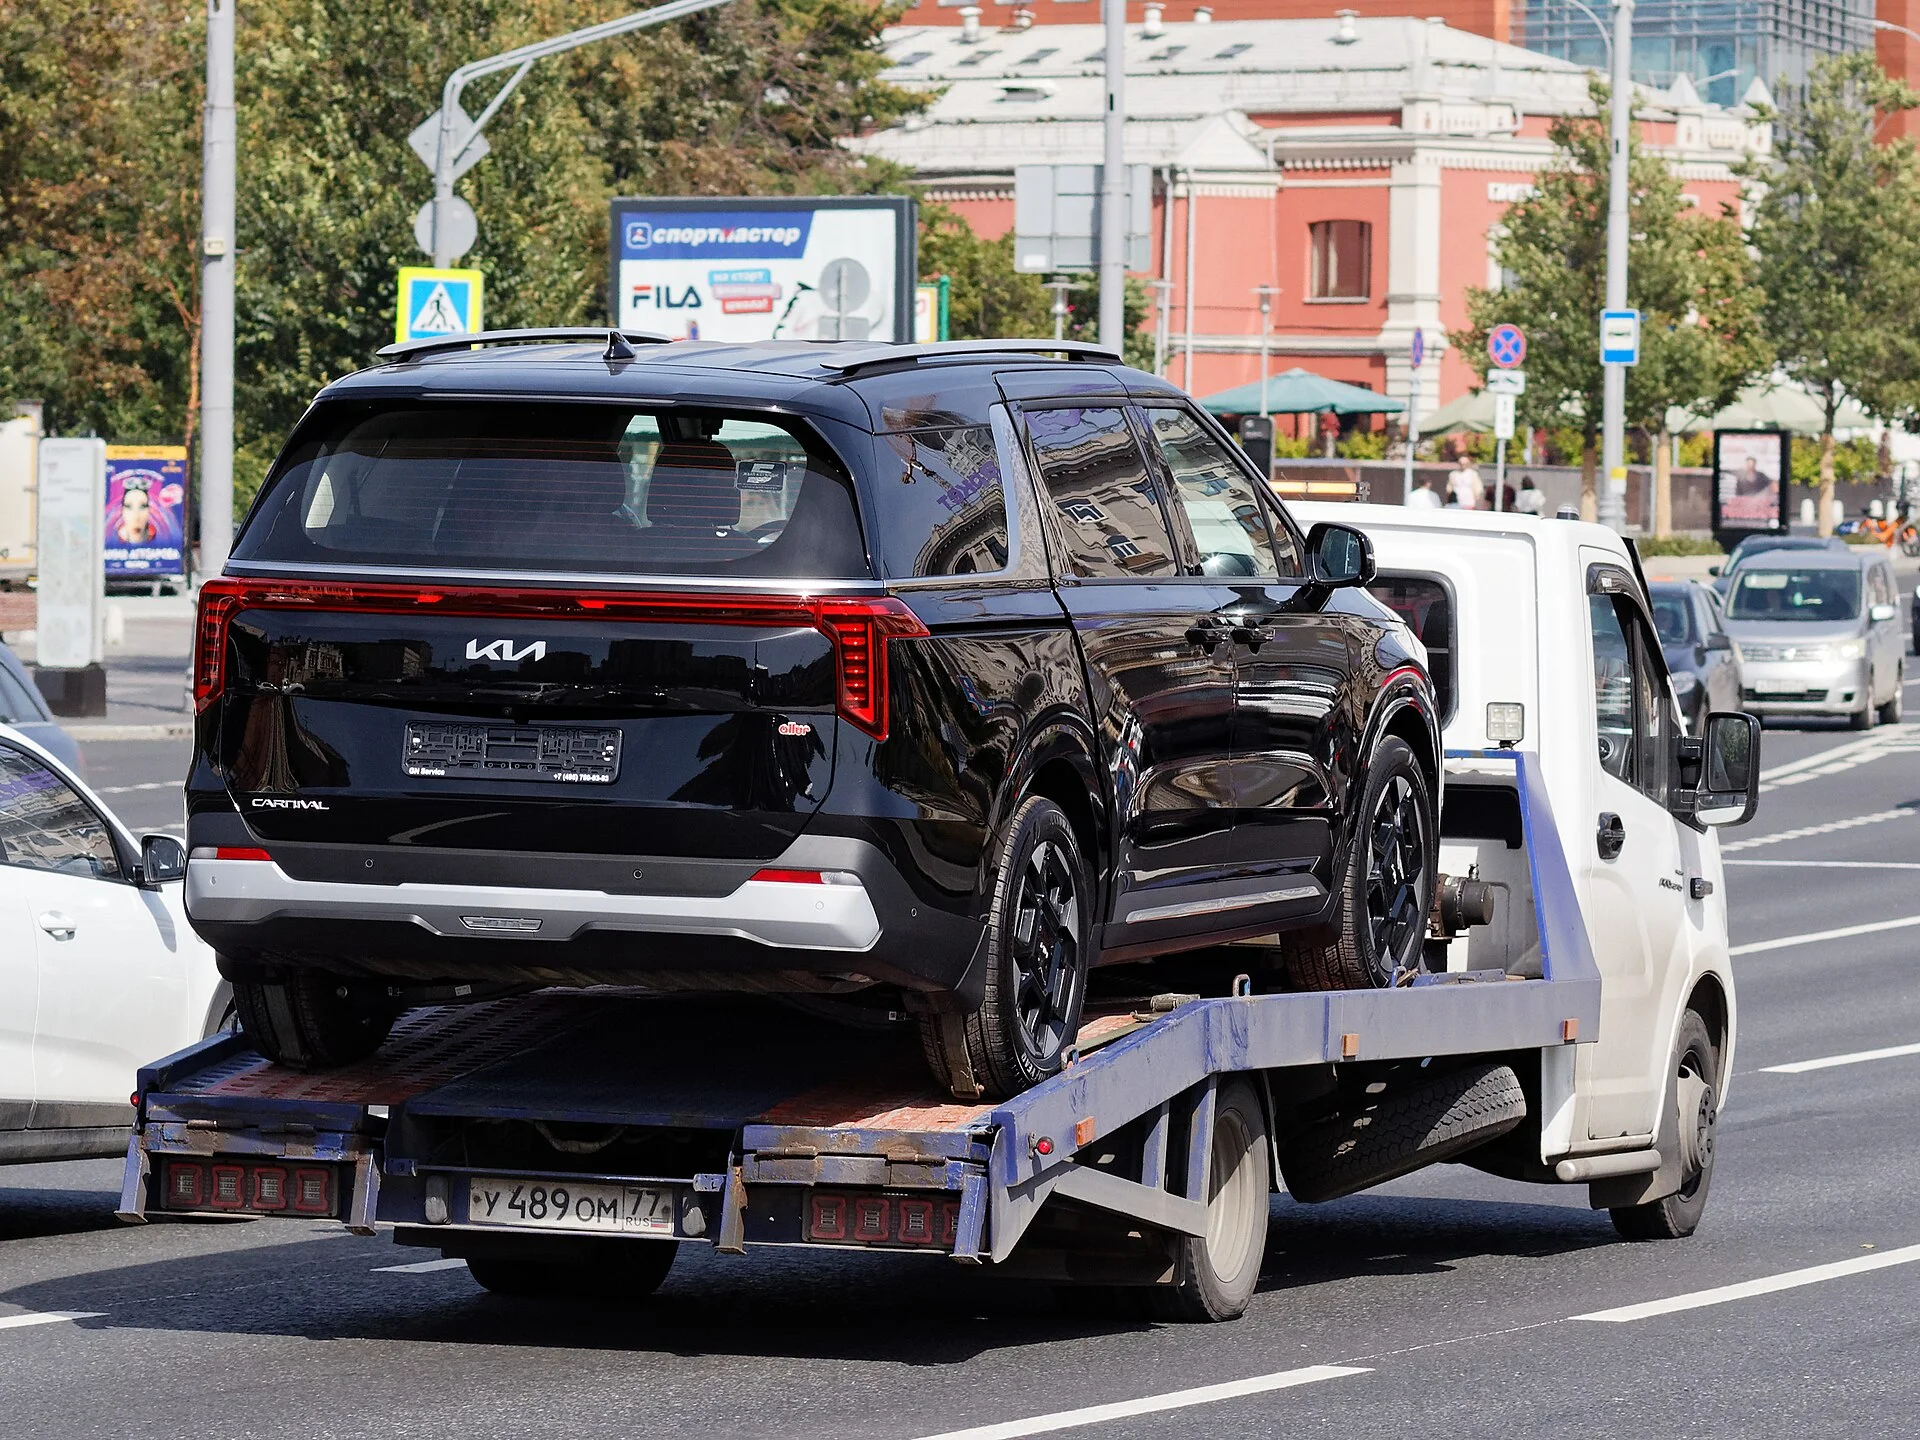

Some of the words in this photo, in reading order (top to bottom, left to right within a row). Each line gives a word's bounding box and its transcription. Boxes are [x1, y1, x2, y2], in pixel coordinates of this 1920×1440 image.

[633, 285, 702, 308] FILA
[465, 638, 547, 662] KIA
[778, 721, 812, 737] allur
[251, 798, 330, 810] CARNIVAL
[628, 1190, 661, 1217] 77
[625, 1216, 650, 1228] RUS
